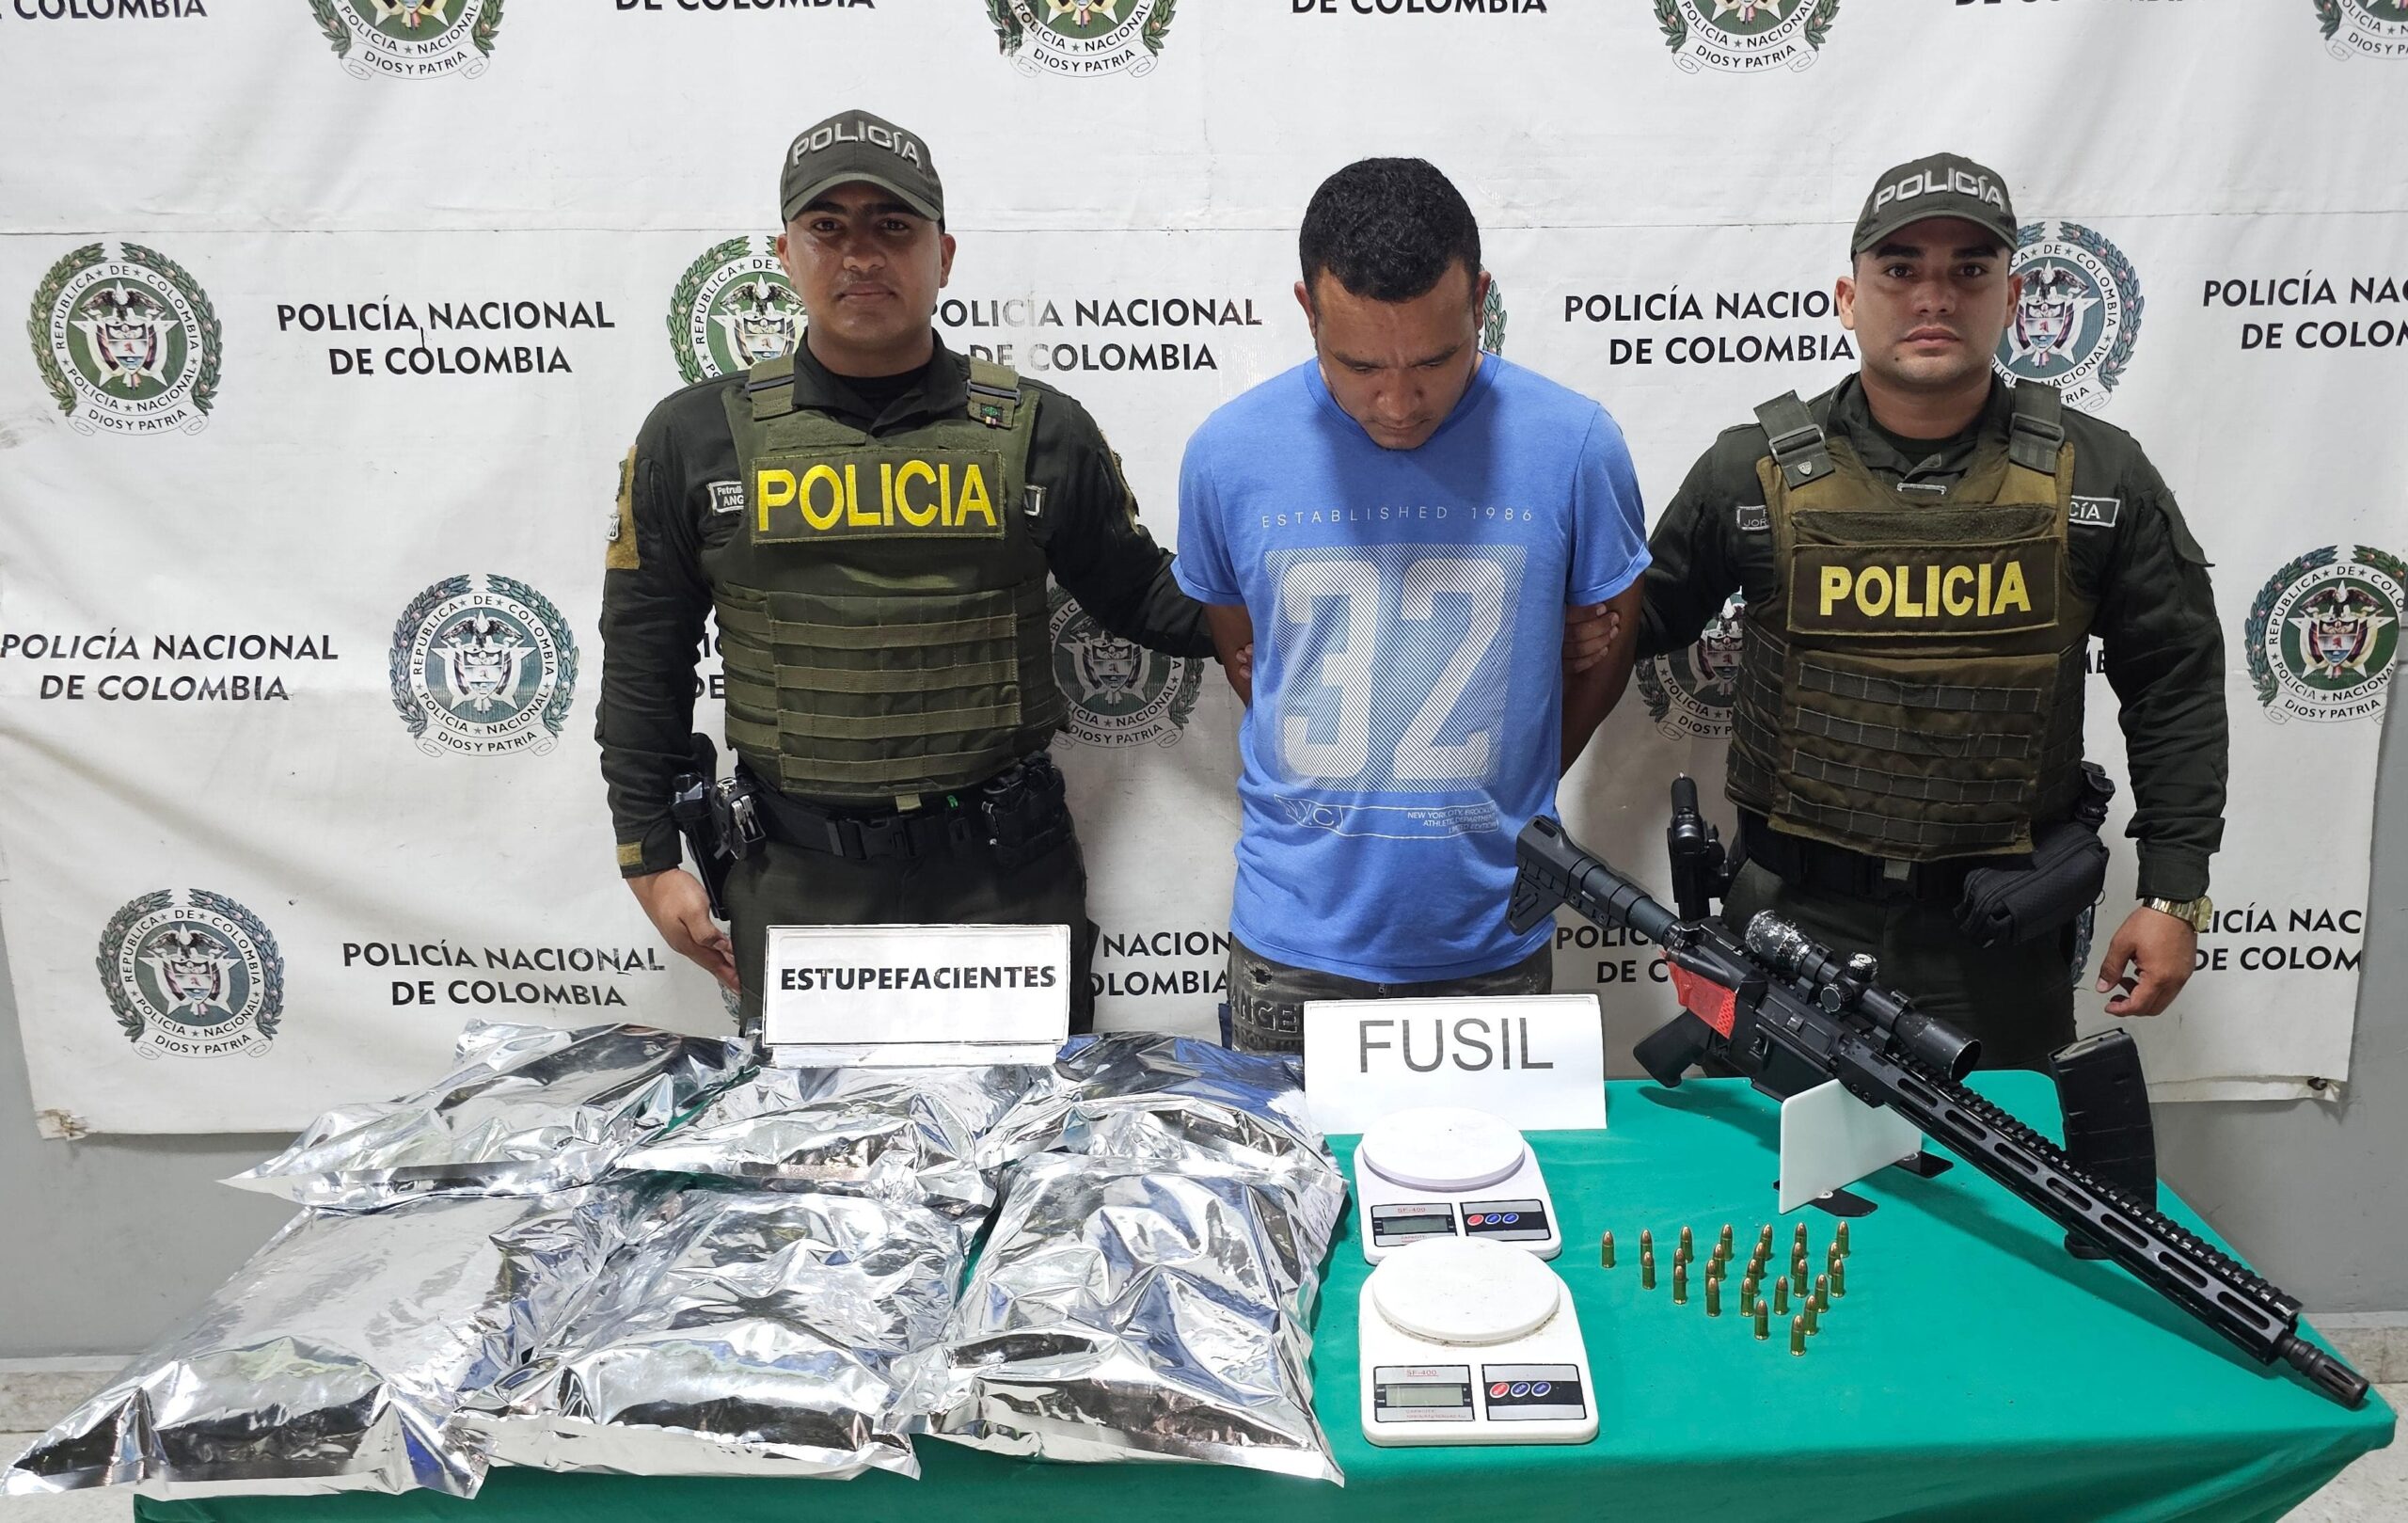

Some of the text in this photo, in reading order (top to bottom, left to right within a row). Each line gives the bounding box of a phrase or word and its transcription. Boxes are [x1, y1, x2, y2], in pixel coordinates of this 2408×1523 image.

[417, 4, 479, 55] NACIONAL
[1085, 3, 1150, 52] NACIONAL
[1747, 0, 1814, 48] NACIONAL
[1695, 44, 1797, 69] DIOS Y PATRIA
[2348, 32, 2382, 54] DIOS
[2385, 44, 2393, 55] Y
[364, 51, 467, 75] DIOS Y PATRIA
[1034, 48, 1135, 72] DIOS Y PATRIA
[792, 119, 923, 169] POLICÍA
[1873, 167, 2007, 214] POLICÍA
[752, 259, 773, 269] DE
[2044, 245, 2116, 328] DE COLOMBIA
[2203, 269, 2337, 307] POLICÍA
[110, 265, 130, 276] DE
[147, 274, 200, 350] COLOMBIA
[277, 295, 616, 331] POLICÍA NACIONAL
[932, 291, 1262, 327] OLICÍA NACIONAL
[1565, 285, 1837, 322] POLICÍA NACIO
[1609, 334, 1856, 365] DE COLOMBIA
[2241, 323, 2284, 350] DE
[329, 345, 573, 374] DE COLOMBIA
[1030, 343, 1218, 372] COLOMBIA
[136, 368, 197, 412] NACIONAL
[88, 408, 188, 431] DIOS Y PATRIA
[757, 459, 997, 531] POLICIA
[1261, 506, 1532, 528] ESTABLISHED 1986
[2337, 566, 2356, 576] DE
[1819, 561, 2032, 618] POLICIA
[0, 627, 340, 659] POLICÍA NACIONAL
[473, 595, 493, 606] DE
[509, 604, 555, 675] COLOMBIA
[1282, 557, 1506, 780] 32
[40, 674, 291, 701] DE COLOMBIA
[486, 691, 549, 735] NACIONAL
[1117, 685, 1177, 727] NACIONAL
[2285, 699, 2381, 719] DIOS Y PATRIA
[1117, 723, 1164, 744] PATRIA
[1677, 715, 1711, 735] DIOS
[437, 731, 537, 753] DIOS Y PATRIA
[1407, 811, 1426, 819] NEW
[175, 910, 196, 919] DE
[212, 917, 261, 986] COLOMBIA
[342, 939, 666, 972] POLICÍA NACIONAL
[1102, 931, 1233, 958] NACION
[780, 965, 1057, 991] ESTUPEFACIENTES
[1597, 960, 1637, 984] DE
[391, 979, 628, 1007] DE COLOMBIA
[203, 999, 260, 1038] NACIONAL
[154, 1034, 252, 1055] DIOS Y PATRIA
[1359, 1017, 1554, 1073] FUSIL
